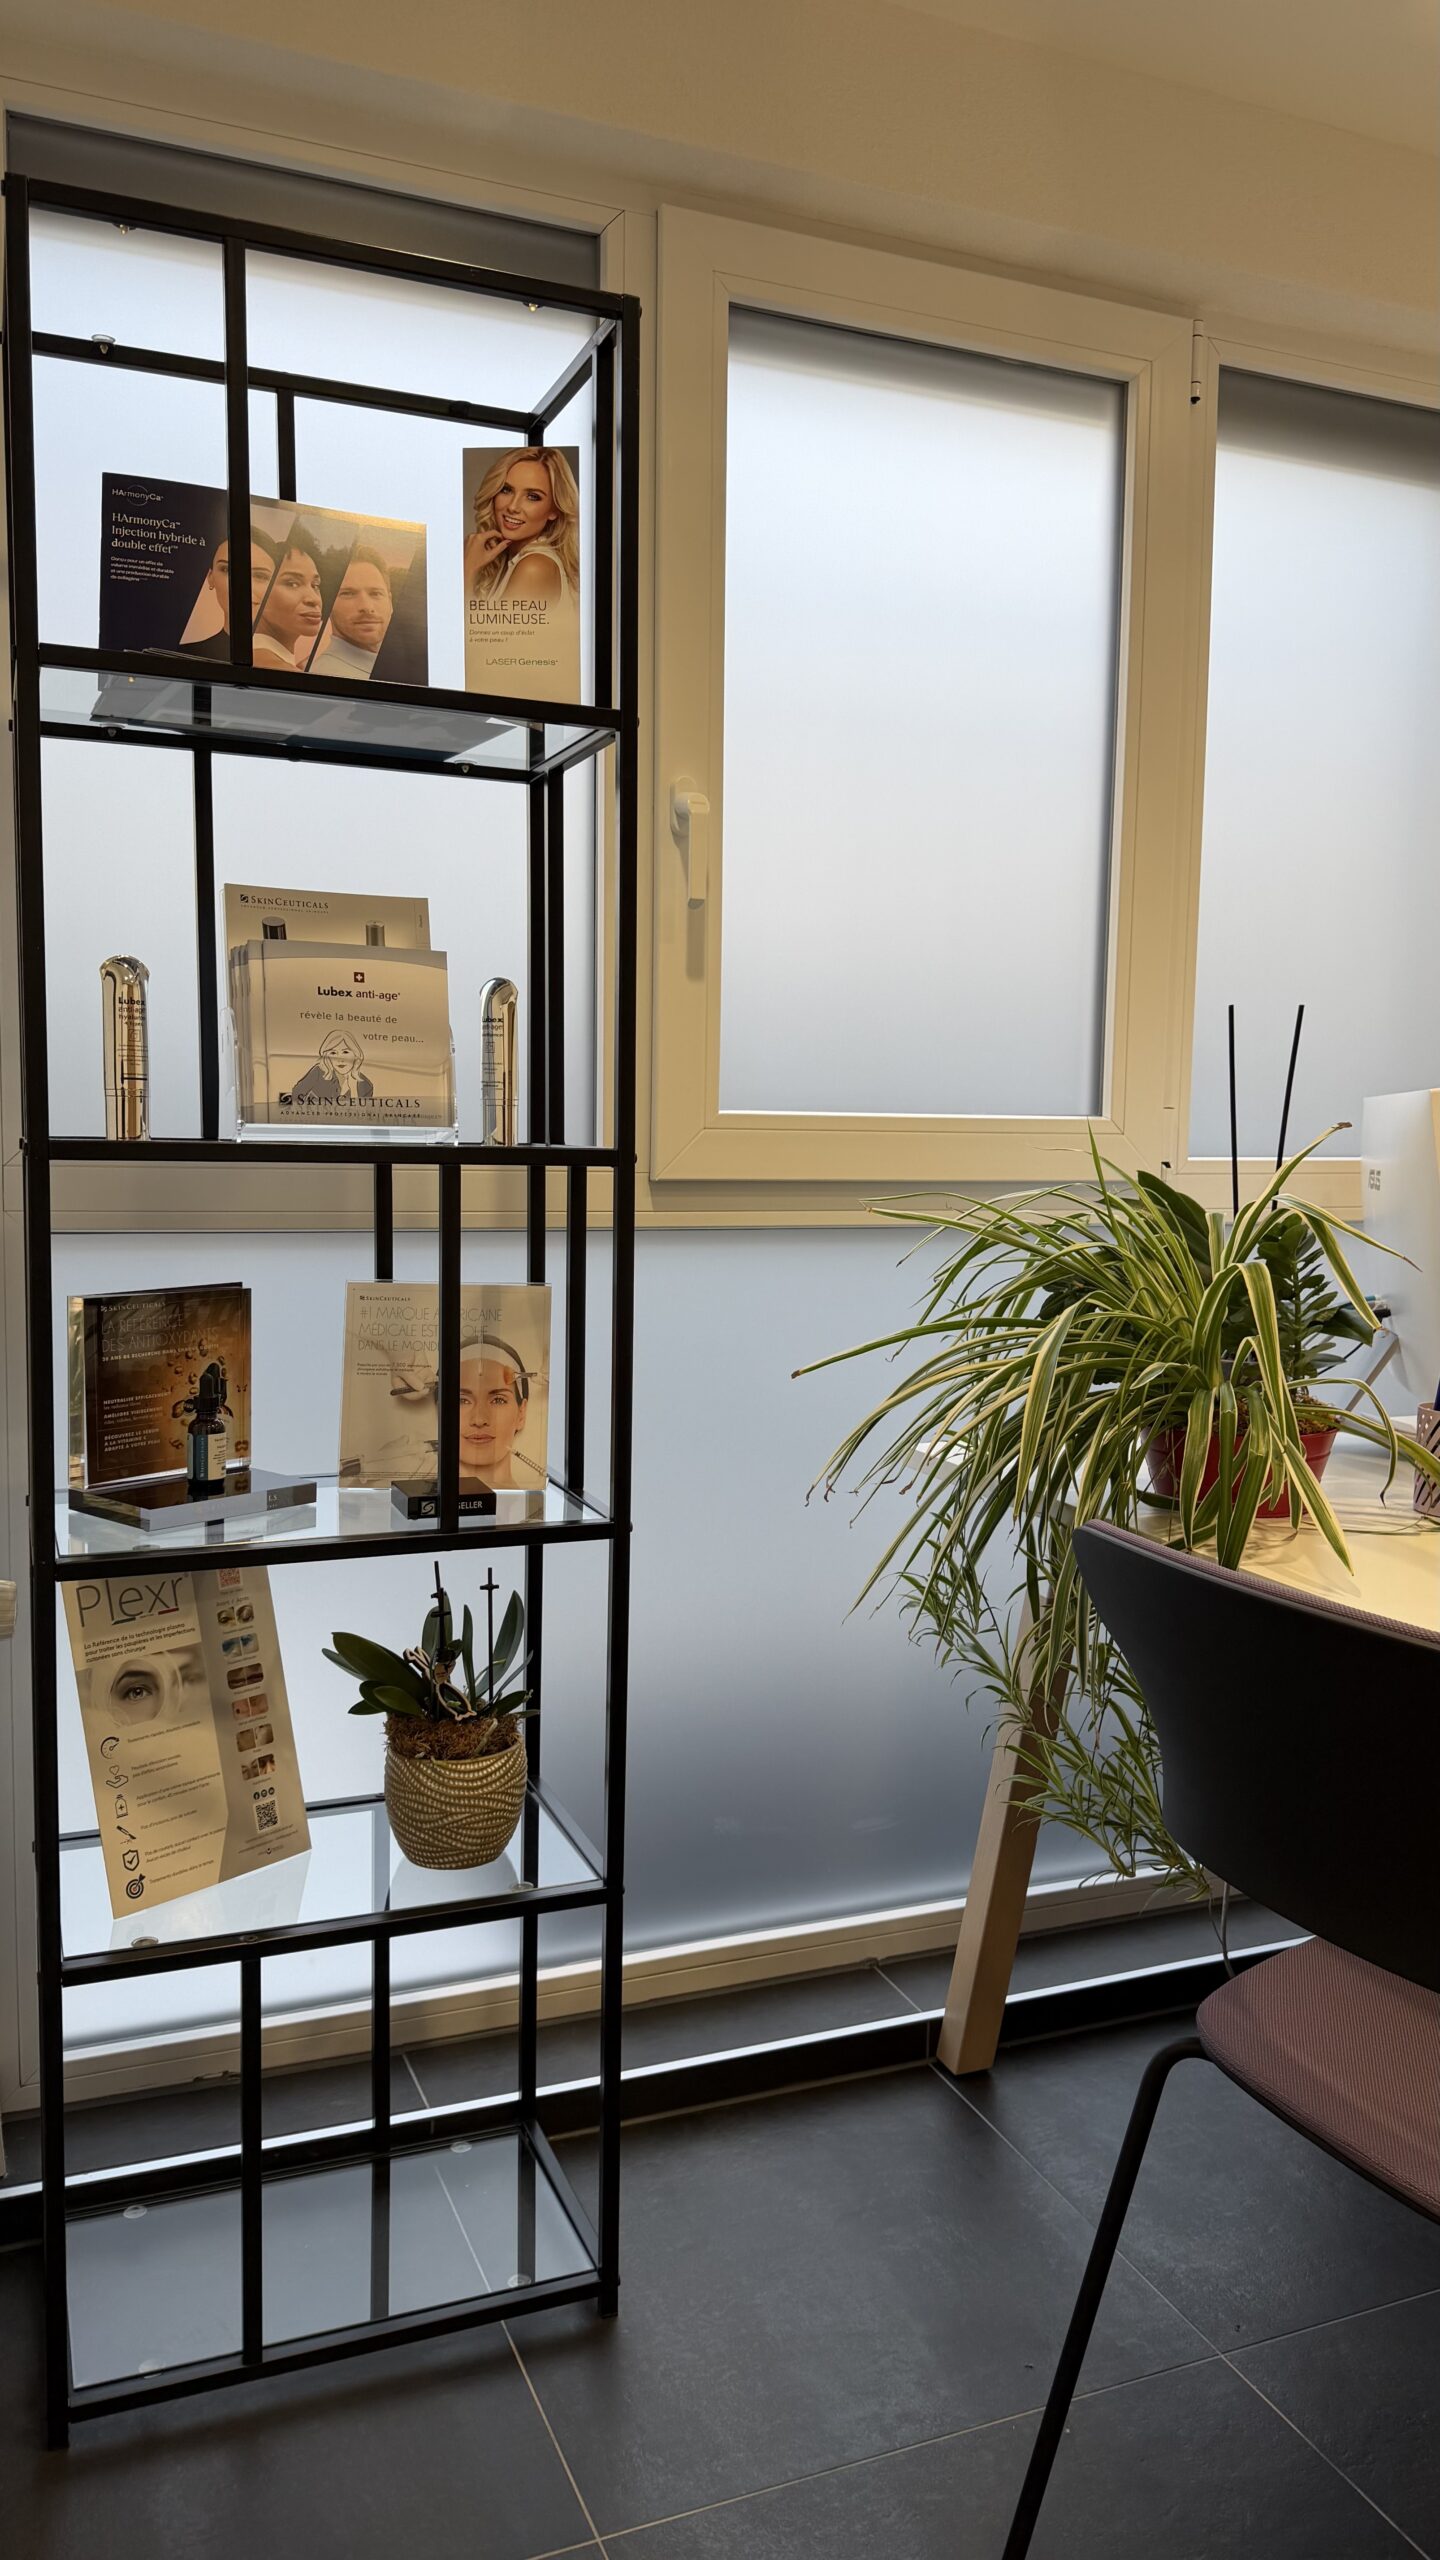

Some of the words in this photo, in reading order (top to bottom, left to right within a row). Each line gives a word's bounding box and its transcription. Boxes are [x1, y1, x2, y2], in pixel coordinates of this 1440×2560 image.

[112, 526, 157, 540] Injection
[158, 531, 198, 546] hybride
[111, 538, 147, 551] double
[469, 600, 508, 611] BELLE
[512, 600, 547, 611] PEAU
[469, 613, 550, 625] LUMINEUSE.
[486, 658, 517, 666] LASER
[317, 986, 354, 998] Lubex
[300, 1011, 332, 1021] révèle
[335, 1013, 344, 1021] la
[347, 1013, 382, 1023] beauté
[385, 1016, 398, 1024] de
[362, 1032, 389, 1041] votre
[376, 1306, 430, 1321] MARQUE
[102, 1337, 126, 1353] DES
